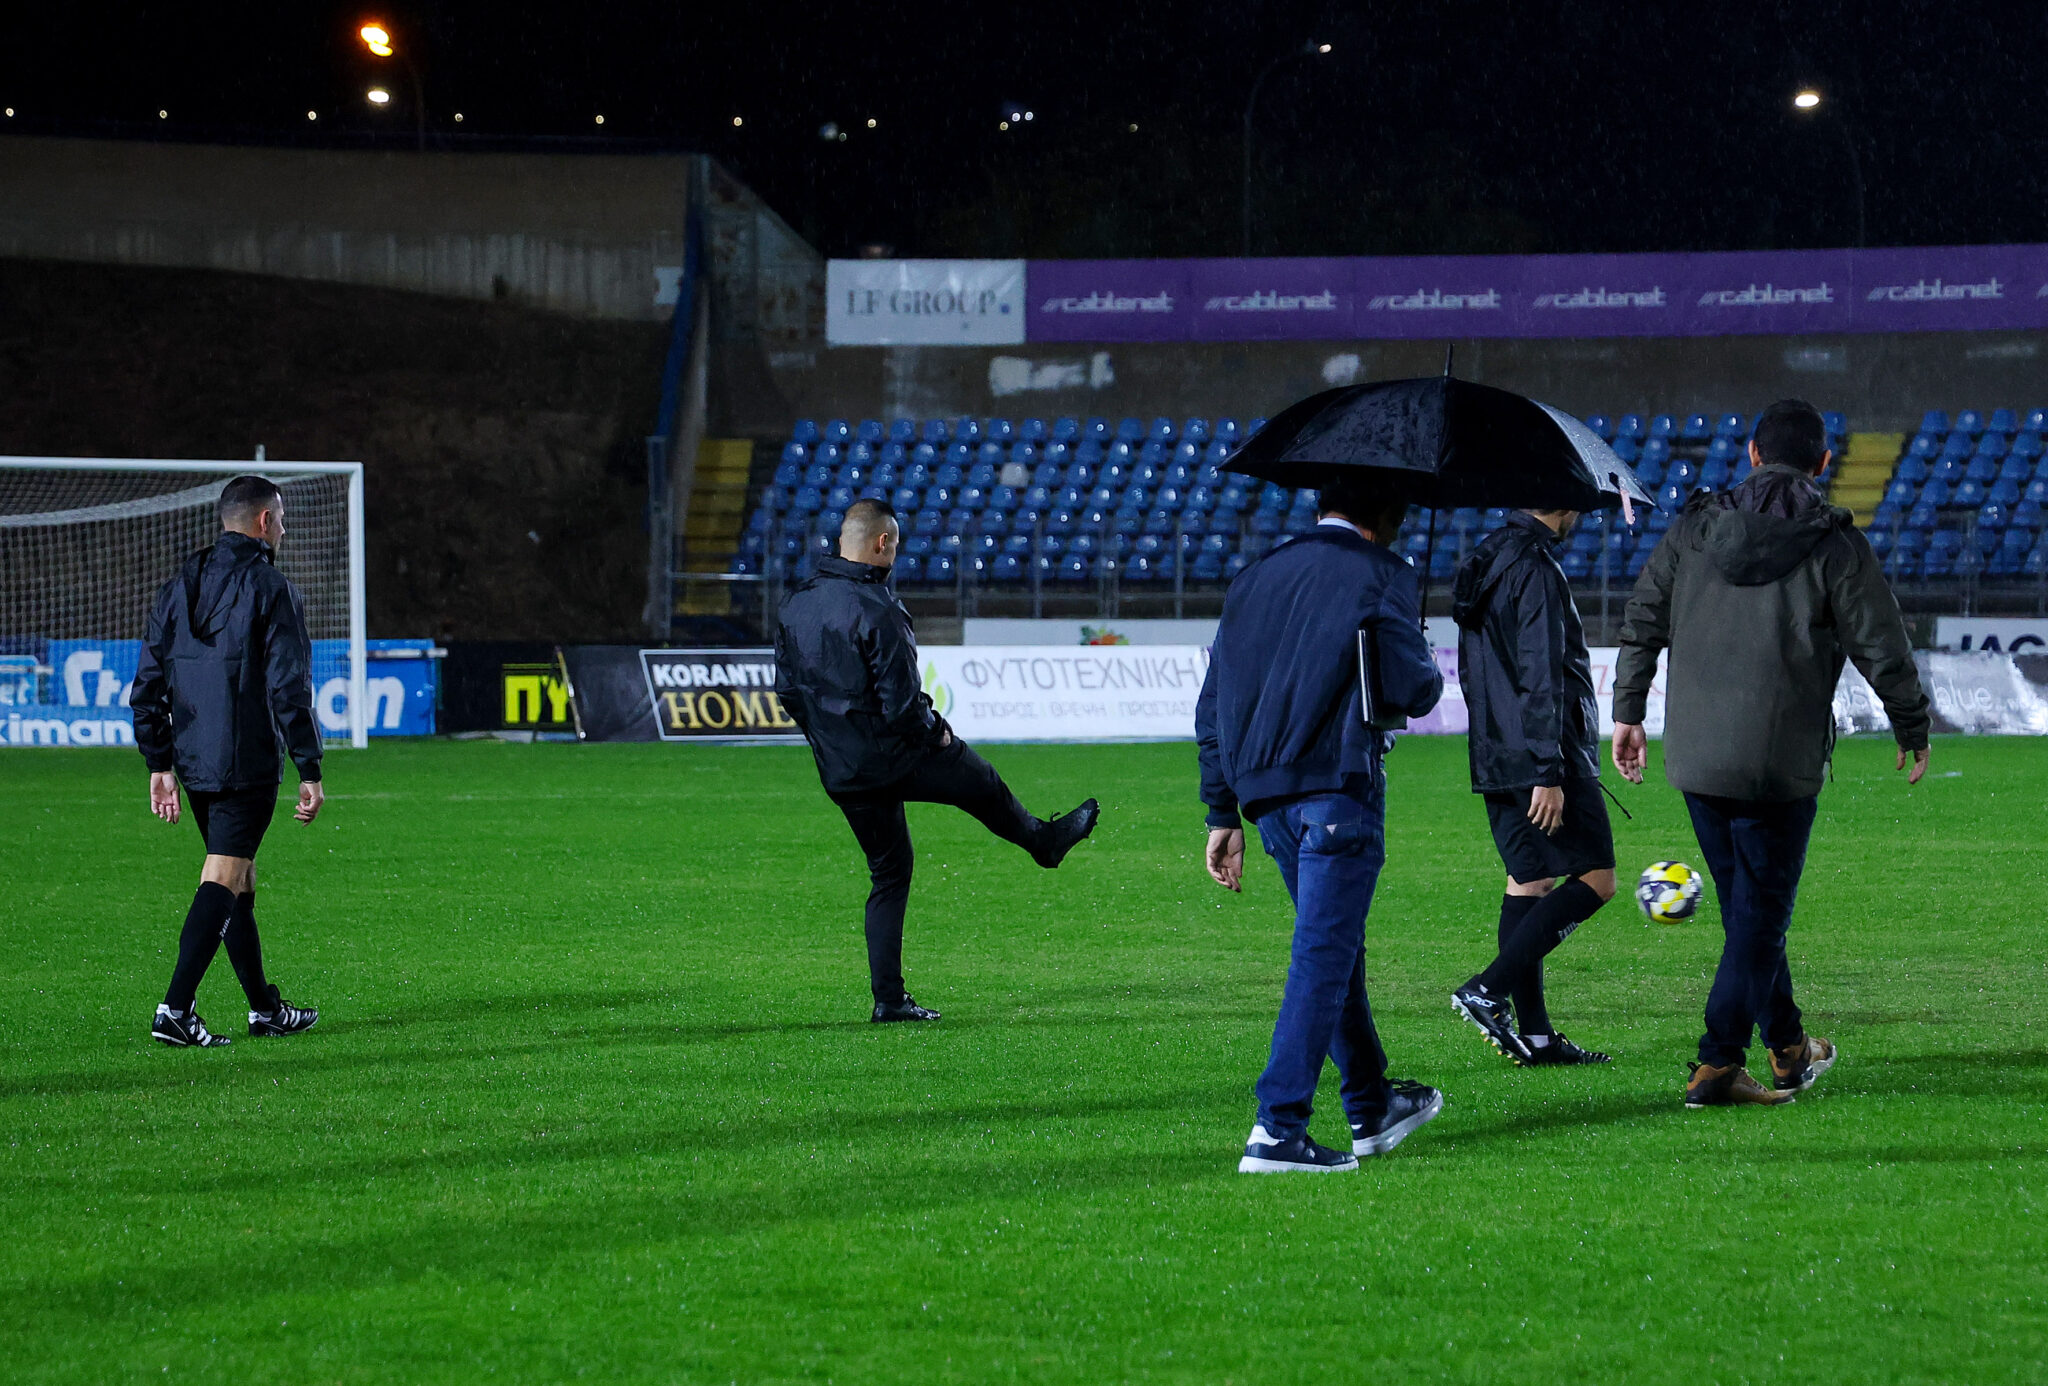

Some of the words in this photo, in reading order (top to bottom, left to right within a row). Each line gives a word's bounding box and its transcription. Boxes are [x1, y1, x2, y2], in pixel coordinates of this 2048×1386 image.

[1225, 289, 1336, 310] cablenet
[1389, 288, 1500, 310] cablenet
[1553, 286, 1667, 308] cablenet
[1719, 281, 1834, 306] cablenet
[1887, 277, 2004, 301] cablenet
[1062, 290, 1174, 313] cablenet
[961, 657, 1201, 689] ΦΥΤΟΤΕΧΝΙΚΗ
